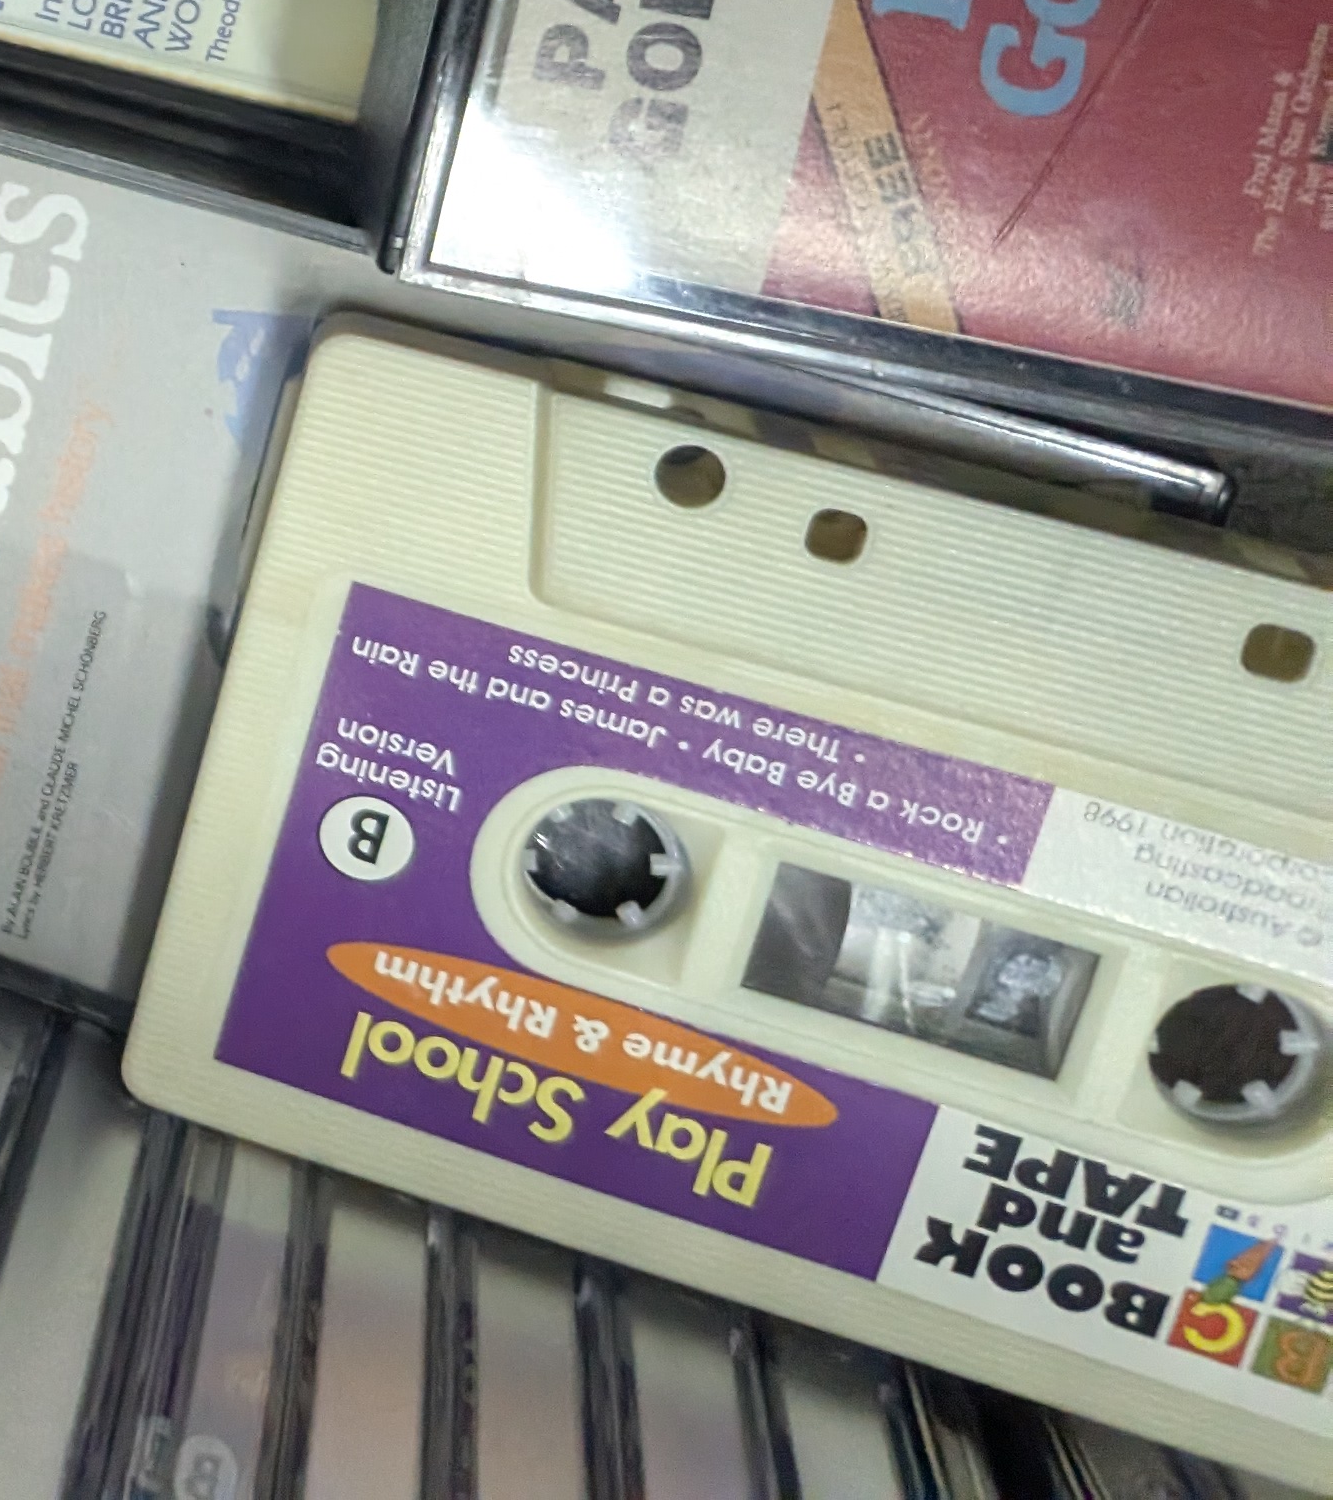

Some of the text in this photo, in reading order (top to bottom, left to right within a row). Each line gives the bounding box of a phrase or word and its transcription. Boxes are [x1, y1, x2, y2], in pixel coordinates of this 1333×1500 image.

[42, 746, 66, 796] CLAUDE
[58, 695, 81, 745] MICHEL
[337, 716, 456, 777] Version
[352, 635, 985, 844] Rock a Bye Baby James and the Rain
[507, 643, 842, 764] There was a Princess
[316, 741, 463, 812] Listening
[1084, 799, 1148, 836] 1998
[346, 808, 390, 866] B
[1145, 877, 1292, 940] Australian
[373, 948, 795, 1117] Rhyme & Rhythm
[341, 1011, 774, 1208] Play School
[962, 1123, 1189, 1238] TAPE
[975, 1183, 1147, 1265] and
[914, 1216, 1171, 1340] BOOK
